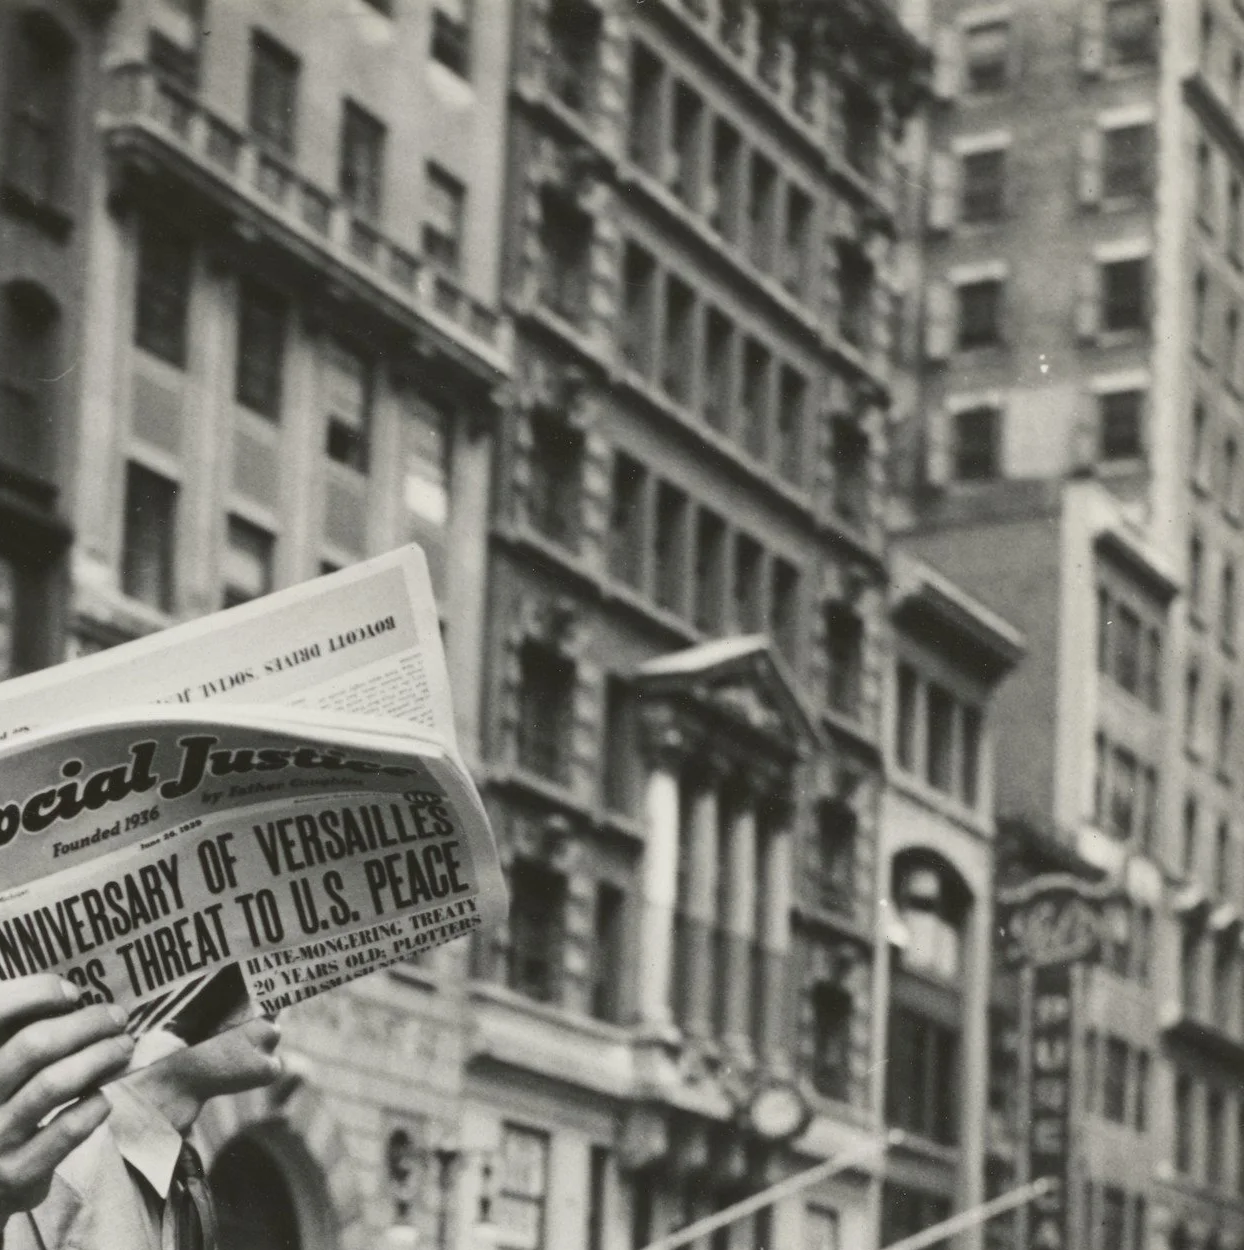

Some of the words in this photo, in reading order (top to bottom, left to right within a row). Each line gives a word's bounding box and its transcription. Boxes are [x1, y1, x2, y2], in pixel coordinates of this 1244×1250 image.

[263, 643, 322, 674] DRIVES
[329, 615, 397, 653] BOYCOTT
[159, 735, 420, 801] Justice
[230, 780, 285, 798] Father
[52, 823, 121, 860] Founded
[123, 805, 161, 834] 1936
[197, 832, 238, 895] OF
[252, 803, 454, 876] VERSAILLES
[116, 903, 231, 998] THREAT
[235, 888, 285, 948] TO
[289, 869, 360, 934] U.S.
[363, 840, 469, 916] PEACE
[247, 920, 403, 976] HATE-MONGERING
[408, 897, 477, 931] TREATY
[253, 977, 276, 997] 20
[281, 959, 339, 985] YEARS
[392, 915, 483, 951] PLOTTERS
